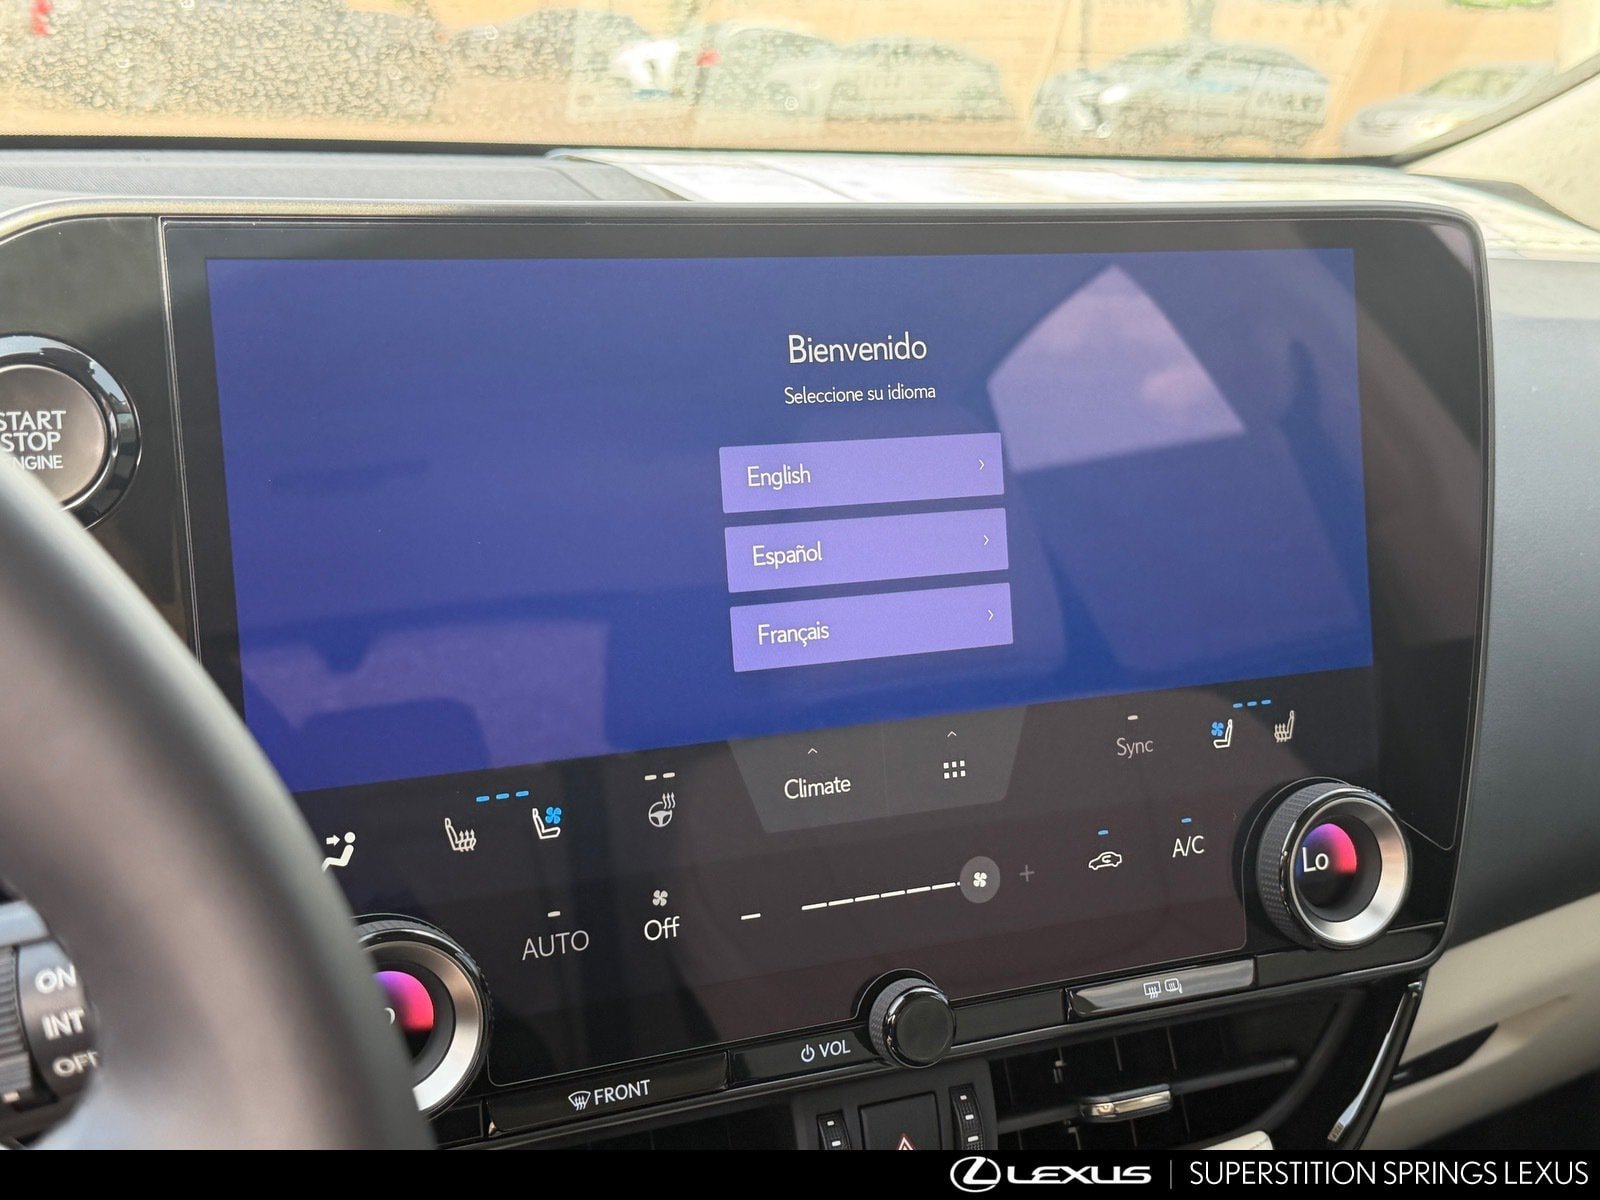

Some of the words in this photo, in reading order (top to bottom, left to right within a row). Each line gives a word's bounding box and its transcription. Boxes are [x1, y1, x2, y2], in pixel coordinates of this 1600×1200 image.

[788, 331, 927, 363] Bienvenido
[784, 386, 863, 404] Seleccione
[868, 387, 883, 401] su
[888, 382, 936, 400] idioma
[0, 410, 66, 431] START
[0, 432, 61, 452] STOP
[12, 454, 63, 471] NGINE
[747, 464, 811, 490] English
[753, 541, 823, 569] Español
[758, 621, 830, 647] Français
[1117, 737, 1154, 758] Sync
[784, 776, 852, 800] Climate
[1172, 835, 1205, 858] A/C
[1302, 847, 1329, 873] Lo
[644, 915, 681, 941] Off
[522, 930, 590, 961] AUTO
[34, 963, 77, 994] ON
[41, 1008, 85, 1041] INT
[819, 1040, 851, 1058] VOL
[594, 1079, 651, 1105] FRONT
